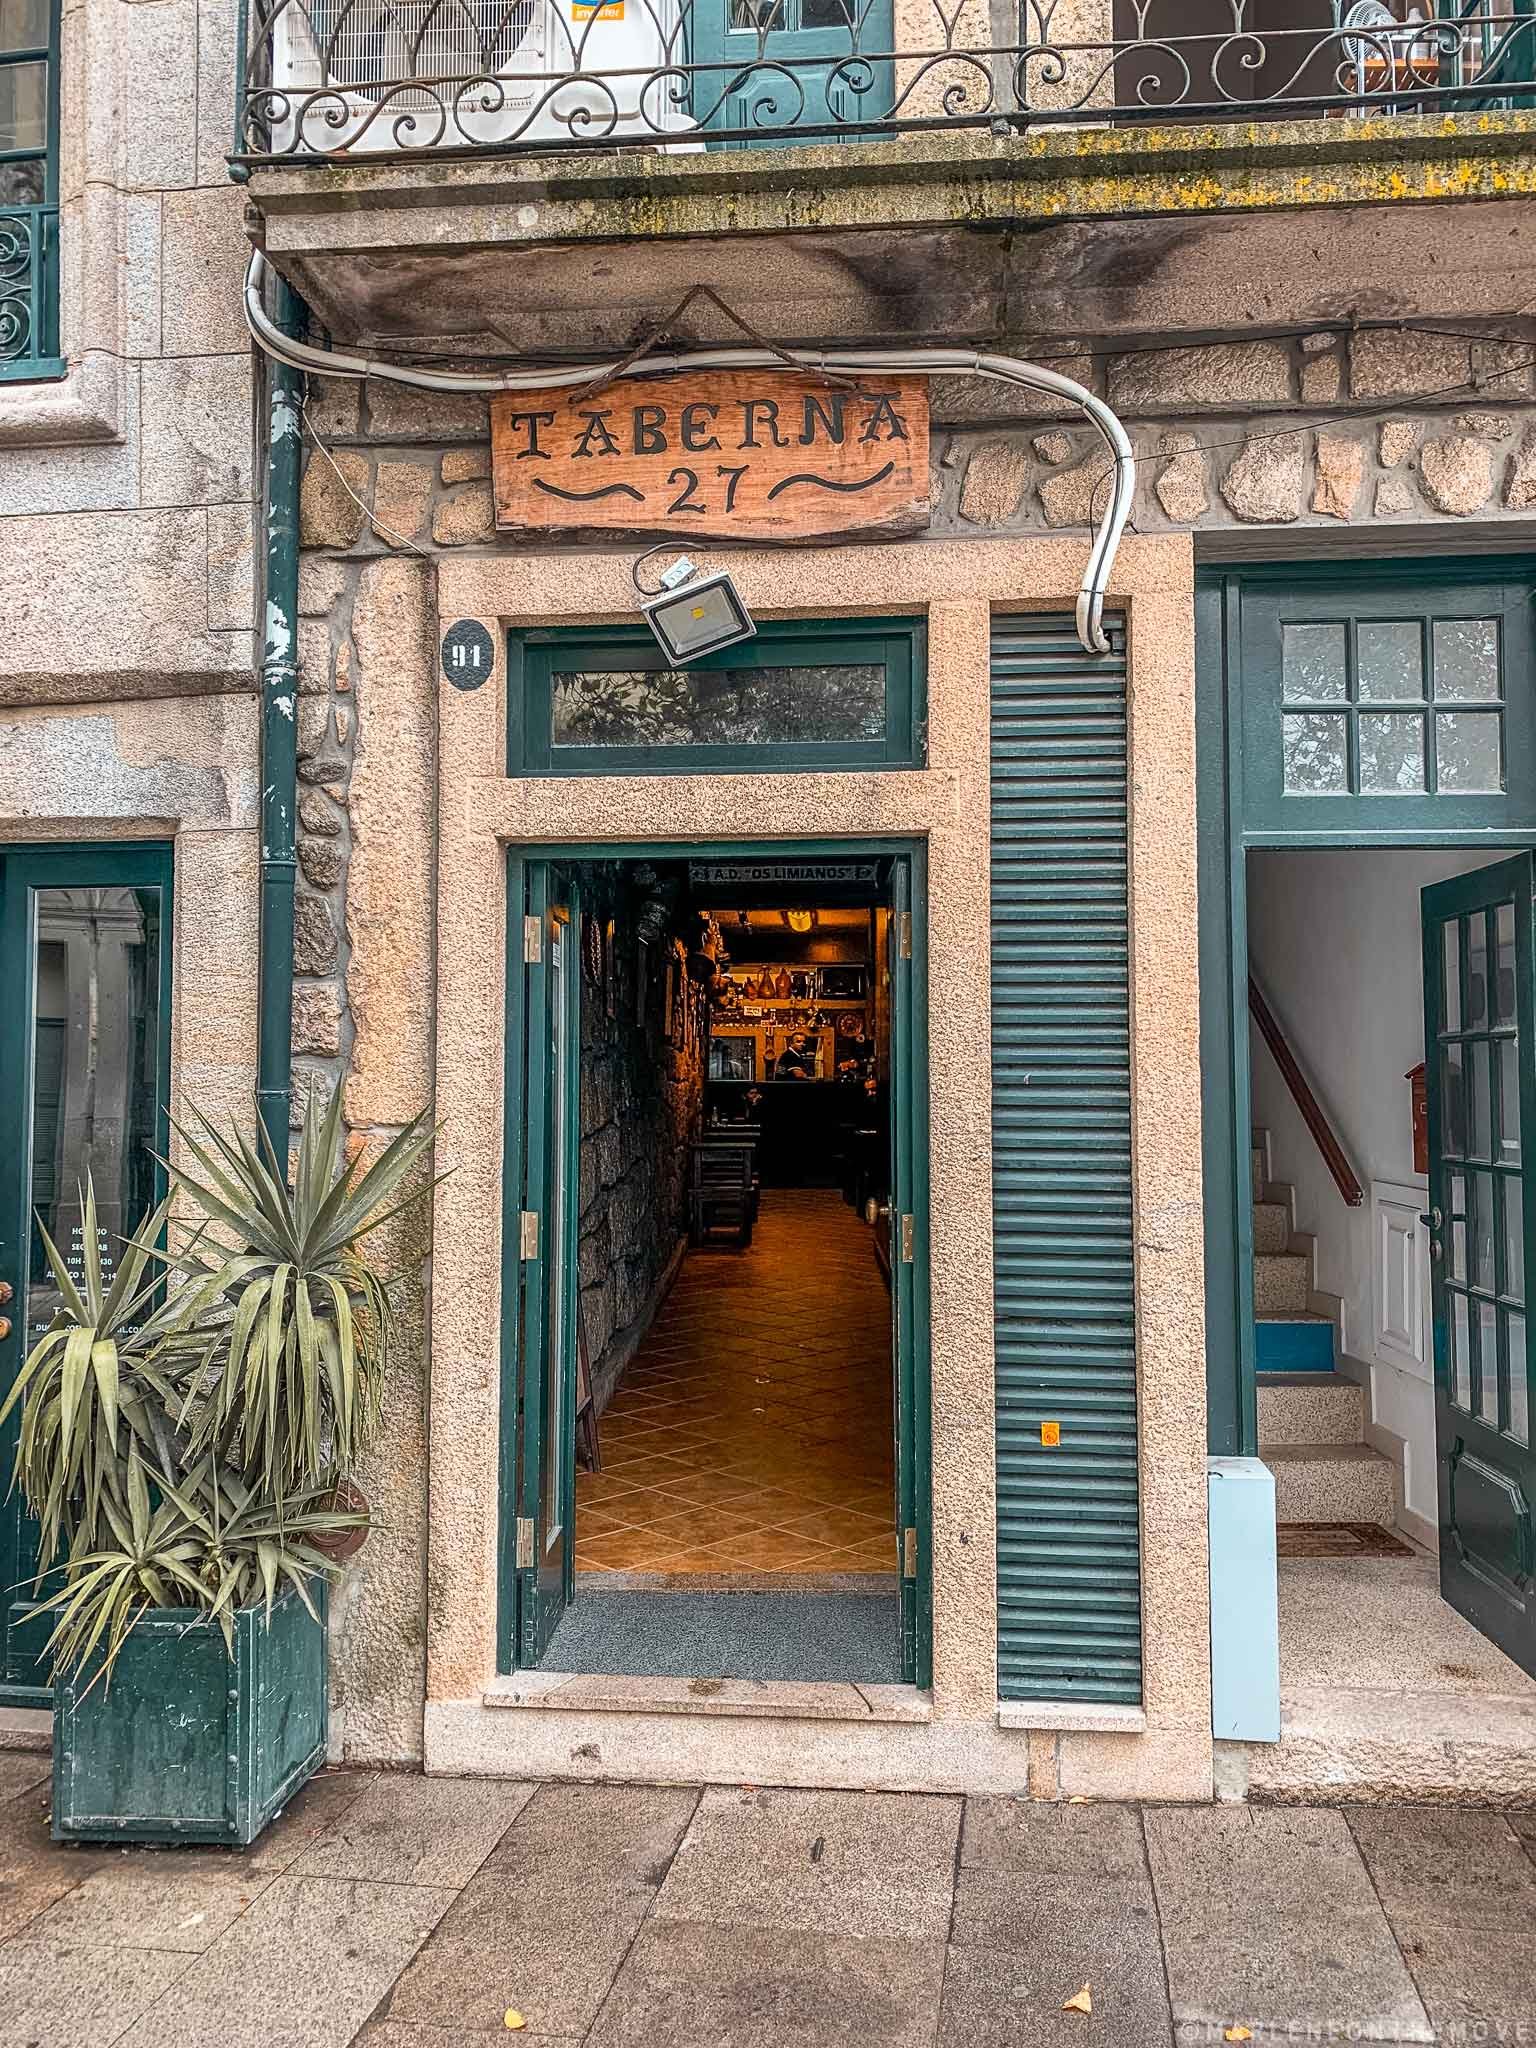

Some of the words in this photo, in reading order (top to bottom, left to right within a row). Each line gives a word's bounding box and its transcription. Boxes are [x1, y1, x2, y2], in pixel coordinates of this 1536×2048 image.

[576, 7, 620, 17] invrter
[510, 391, 910, 460] TABERNA
[666, 465, 750, 514] 27
[452, 644, 481, 667] 91
